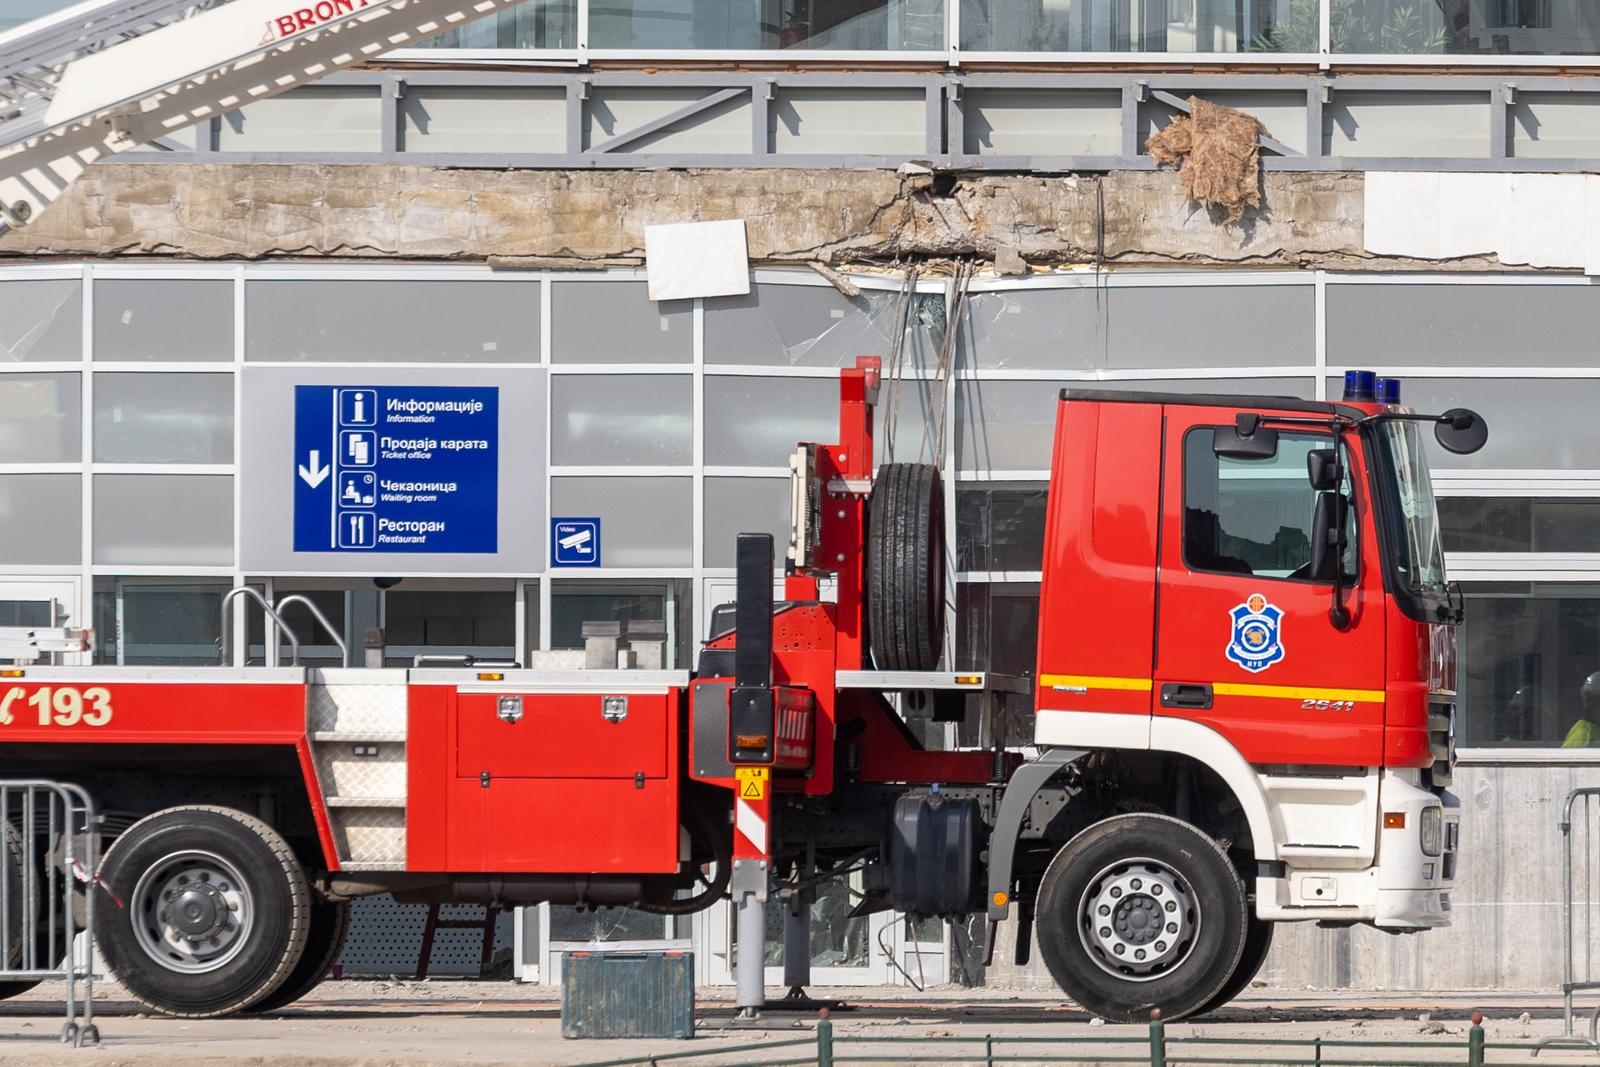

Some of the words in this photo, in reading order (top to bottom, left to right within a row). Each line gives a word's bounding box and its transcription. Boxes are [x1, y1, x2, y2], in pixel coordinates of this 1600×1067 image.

[274, 0, 369, 37] BRON
[386, 398, 483, 414] Информације
[386, 414, 435, 423] Information
[380, 437, 438, 451] Продаја
[440, 439, 488, 451] карата
[381, 451, 406, 459] Ticket
[407, 451, 431, 459] office
[380, 480, 458, 493] Чекаоница
[380, 493, 413, 504] Waiting
[413, 494, 437, 502] room
[378, 518, 445, 535] Ресторан
[378, 534, 426, 543] Restaurant
[28, 687, 113, 727] 193
[1300, 698, 1355, 712] 2641
